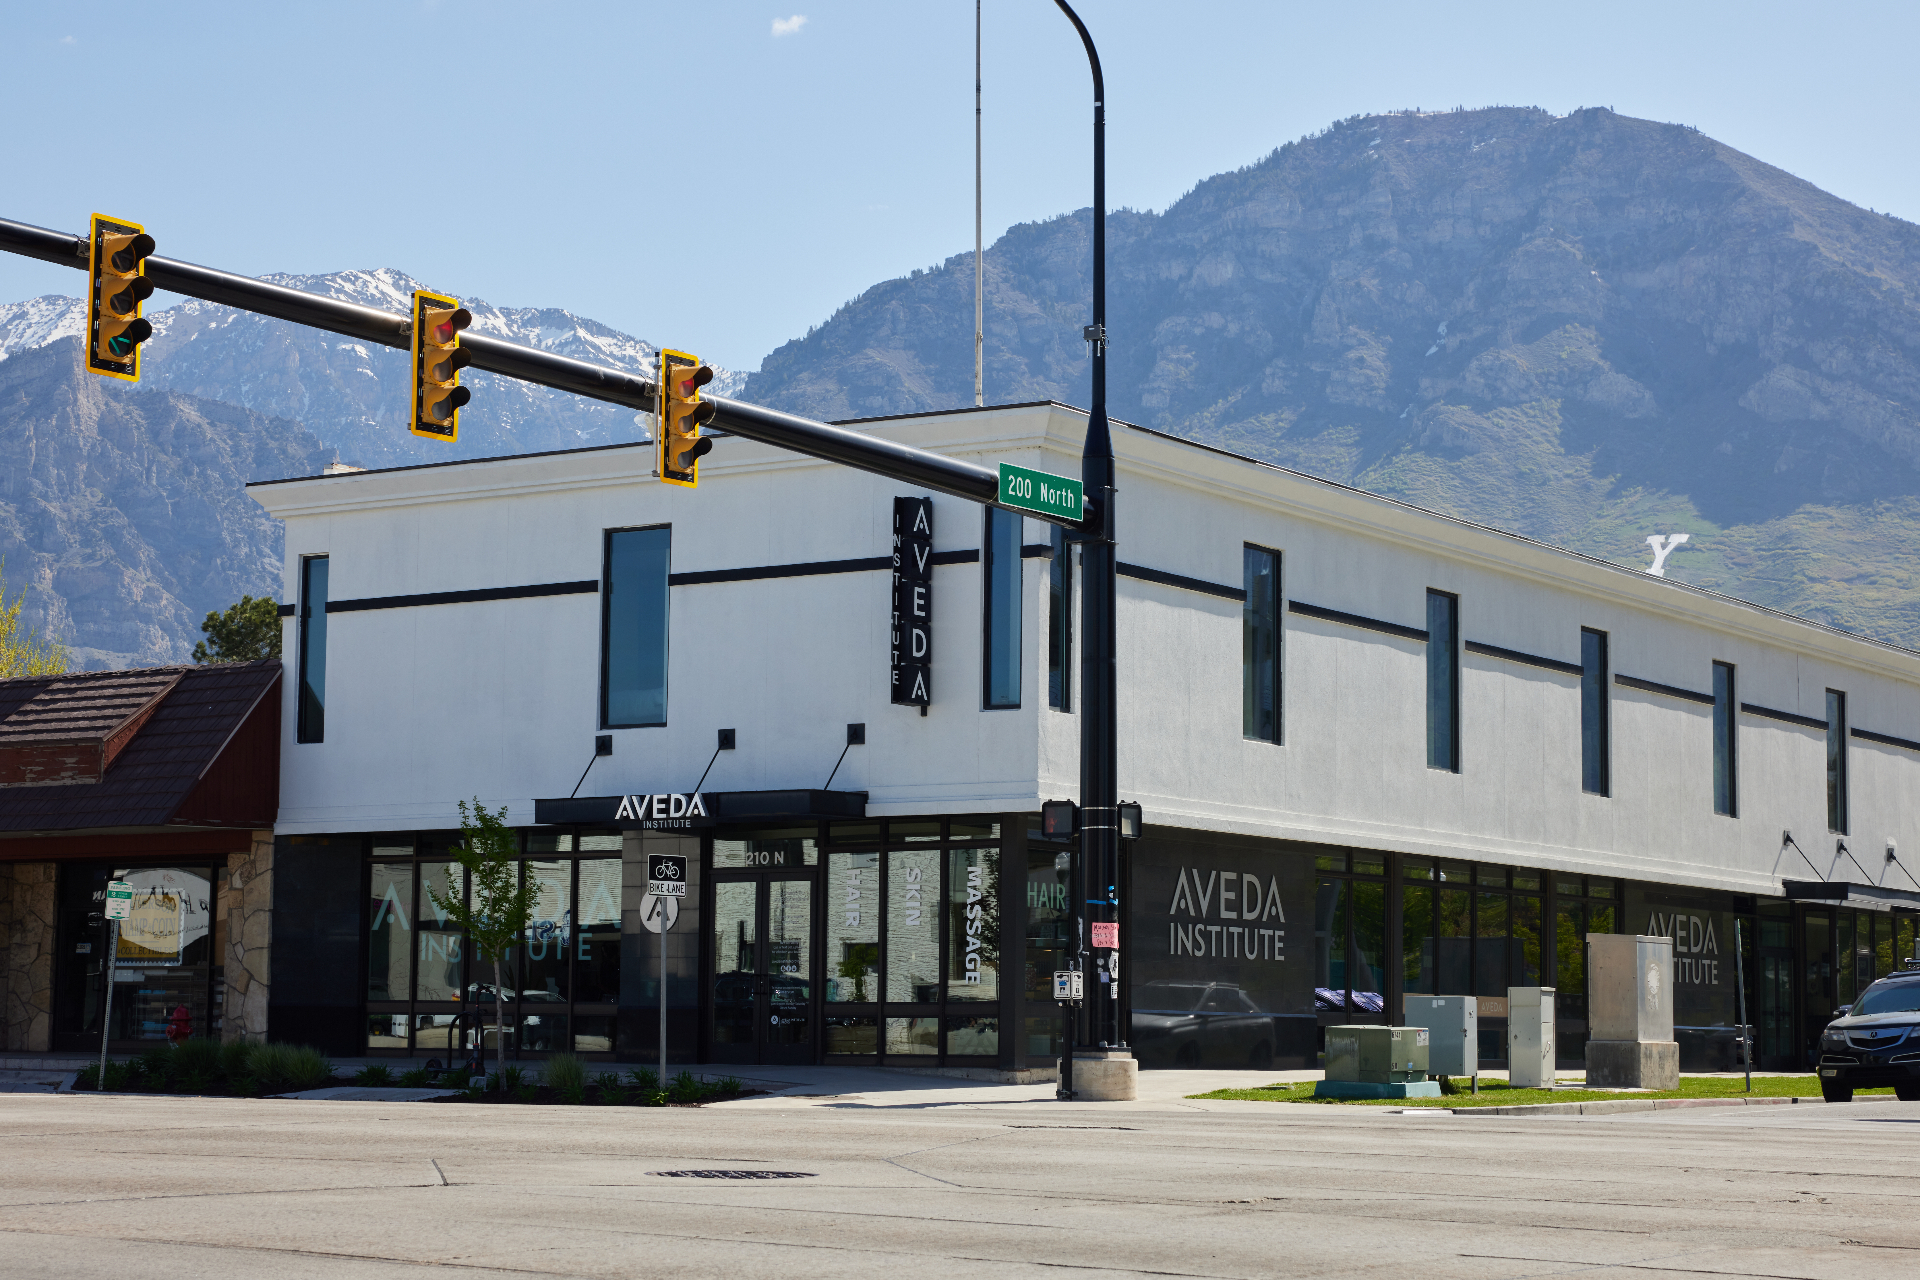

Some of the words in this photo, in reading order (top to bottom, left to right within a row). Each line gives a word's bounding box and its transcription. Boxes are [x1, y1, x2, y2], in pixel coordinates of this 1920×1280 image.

[1008, 475, 1031, 499] 200
[1040, 482, 1075, 508] North
[1645, 533, 1690, 577] Y
[892, 514, 901, 685] INSTITUTE
[911, 503, 930, 701] AVEDA
[615, 792, 707, 821] AVEDA
[643, 820, 691, 829] INSTITUTE
[746, 851, 770, 865] 210
[774, 850, 784, 865] N
[650, 882, 665, 893] BIKE
[667, 883, 685, 894] LANE
[845, 869, 861, 927] HAIR
[905, 867, 922, 926] SKIN
[1027, 881, 1066, 910] HAIR
[1169, 865, 1286, 923] AVEDA
[152, 918, 177, 937] COIN
[966, 866, 983, 985] MASSAGE
[1170, 922, 1285, 961] INSTITUTE
[1647, 911, 1718, 955] AVEDA
[121, 946, 174, 956] COLLECTIBLES
[1480, 1002, 1503, 1012] AVEDA
